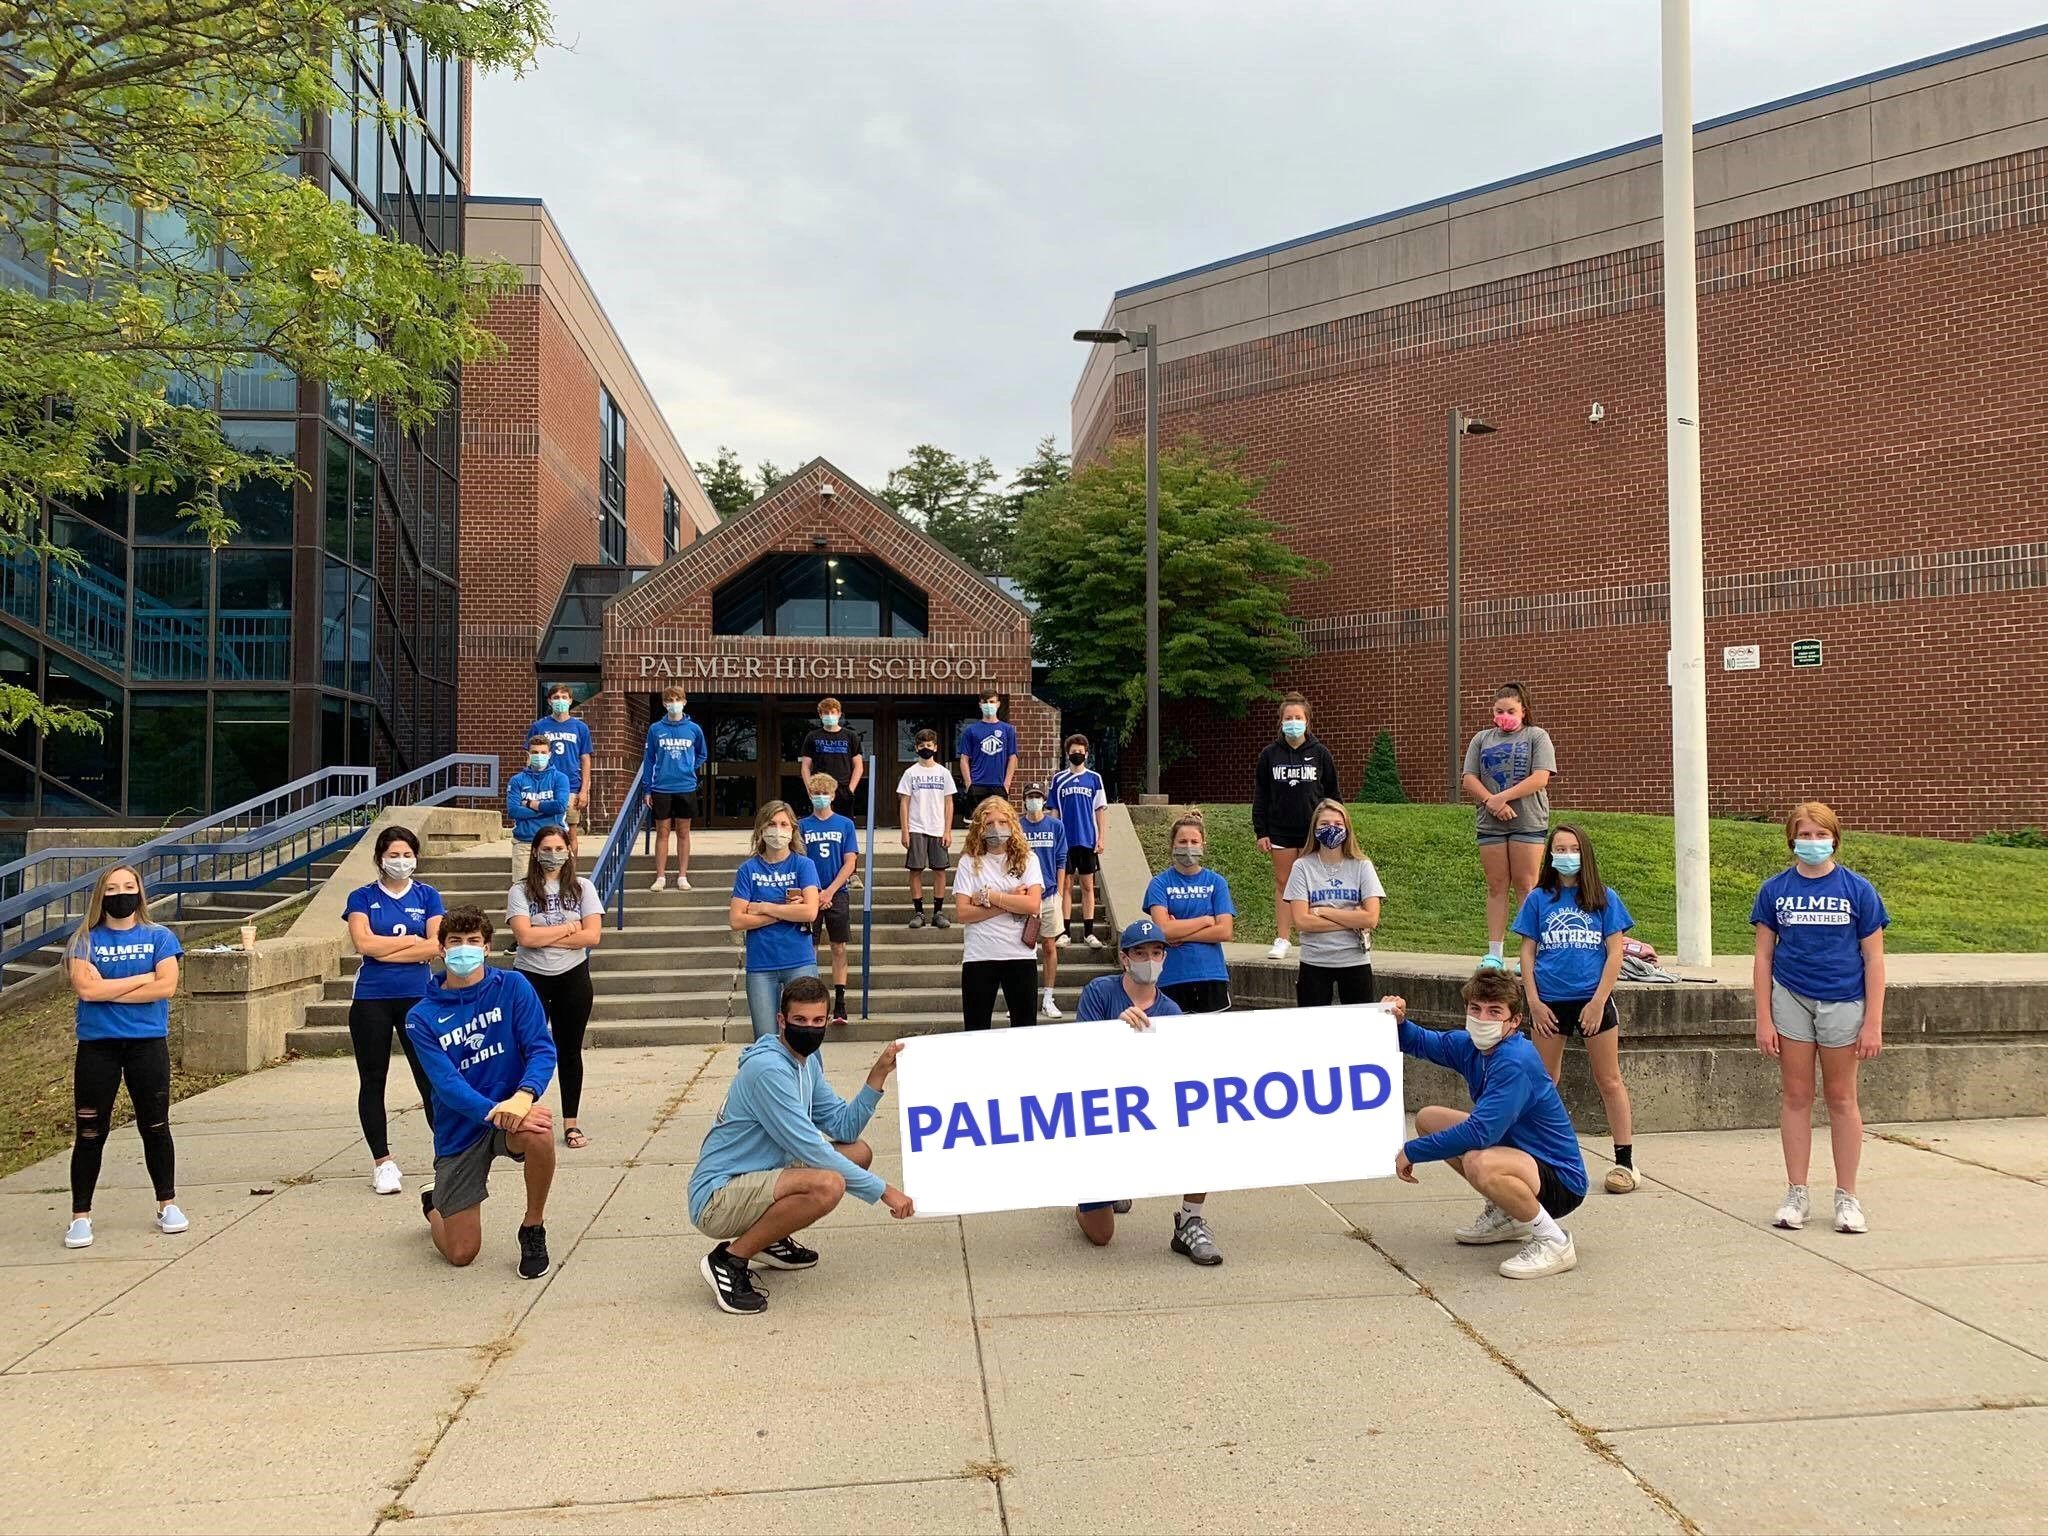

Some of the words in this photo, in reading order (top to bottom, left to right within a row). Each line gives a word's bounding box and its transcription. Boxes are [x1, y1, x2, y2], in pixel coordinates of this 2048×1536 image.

[639, 656, 764, 678] PALMER
[775, 657, 856, 679] HIGH
[868, 657, 997, 680] SCHOOL
[543, 731, 577, 744] PALMER
[815, 739, 848, 747] PALMER
[555, 742, 565, 755] 3
[911, 775, 945, 784] PALMER
[1272, 766, 1287, 780] WE
[1287, 768, 1300, 779] ARE
[1061, 786, 1092, 798] PANTHERS
[804, 831, 842, 844] PALMER
[1023, 831, 1054, 840] ALMER
[819, 842, 830, 858] 5
[1167, 884, 1214, 895] PALMER
[1311, 888, 1360, 903] ANTHER
[1775, 896, 1852, 914] PALMER
[1558, 906, 1594, 925] BALLERS
[1796, 914, 1849, 923] PANTHERS
[1141, 922, 1153, 935] P
[95, 943, 154, 956] ALMER
[1540, 942, 1599, 951] BASKETBALL
[97, 953, 146, 963] OCCER
[907, 1085, 1157, 1152] PALMER
[1173, 1063, 1392, 1127] PROUD
